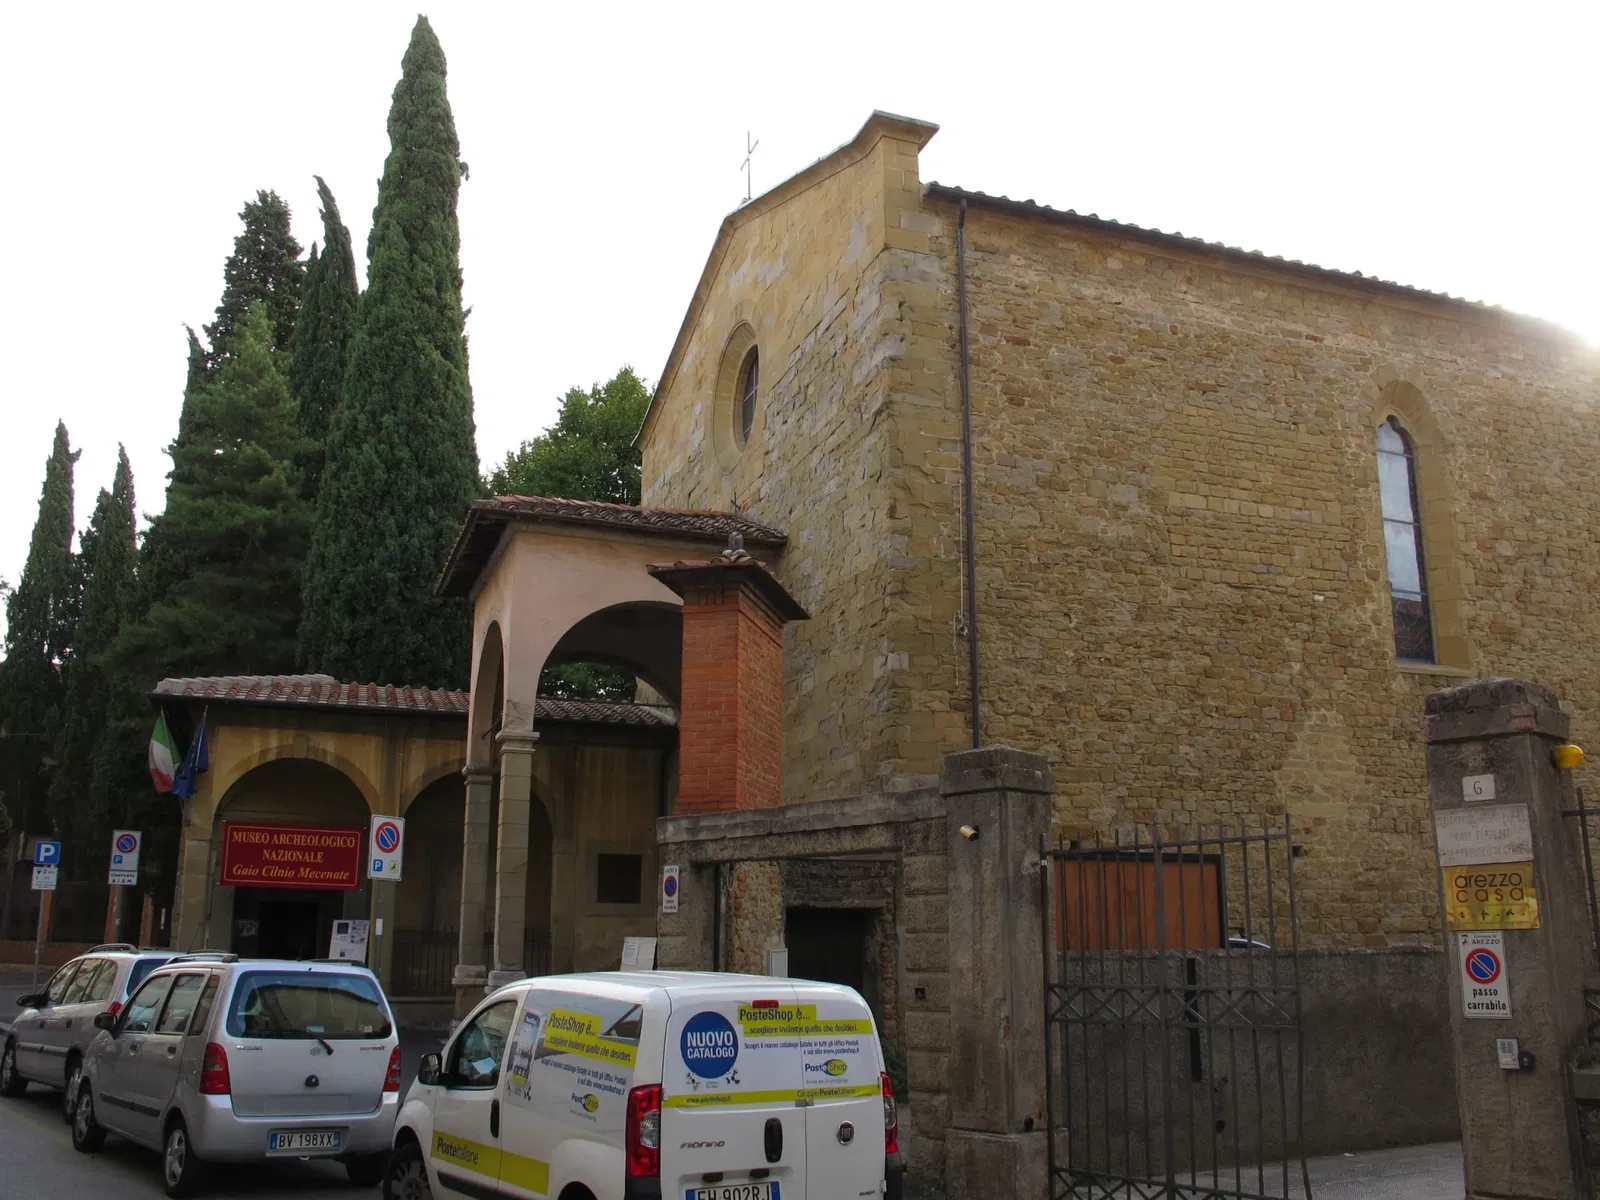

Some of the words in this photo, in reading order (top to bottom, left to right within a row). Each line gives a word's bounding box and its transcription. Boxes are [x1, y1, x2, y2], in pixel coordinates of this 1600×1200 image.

[232, 831, 269, 843] MUSEO
[272, 833, 355, 848] ARCHEOLOGICO
[39, 844, 55, 862] P
[262, 849, 324, 863] NAZIONALE
[232, 864, 258, 876] Gaio
[262, 865, 295, 878] Cilnio
[299, 868, 350, 880] Mecenate
[374, 860, 382, 871] P
[1454, 872, 1523, 889] arezzo
[1456, 887, 1524, 903] casa
[1473, 987, 1498, 998] passo
[1467, 1000, 1507, 1011] carrabile
[740, 1008, 793, 1022] PosteShop
[548, 1012, 585, 1036] PosteShop
[805, 1024, 822, 1034] quello
[823, 1024, 834, 1032] che
[687, 1030, 733, 1047] NUOVO
[687, 1047, 735, 1059] CATALOGO
[278, 1134, 294, 1148] BV
[299, 1133, 333, 1147] 198XX
